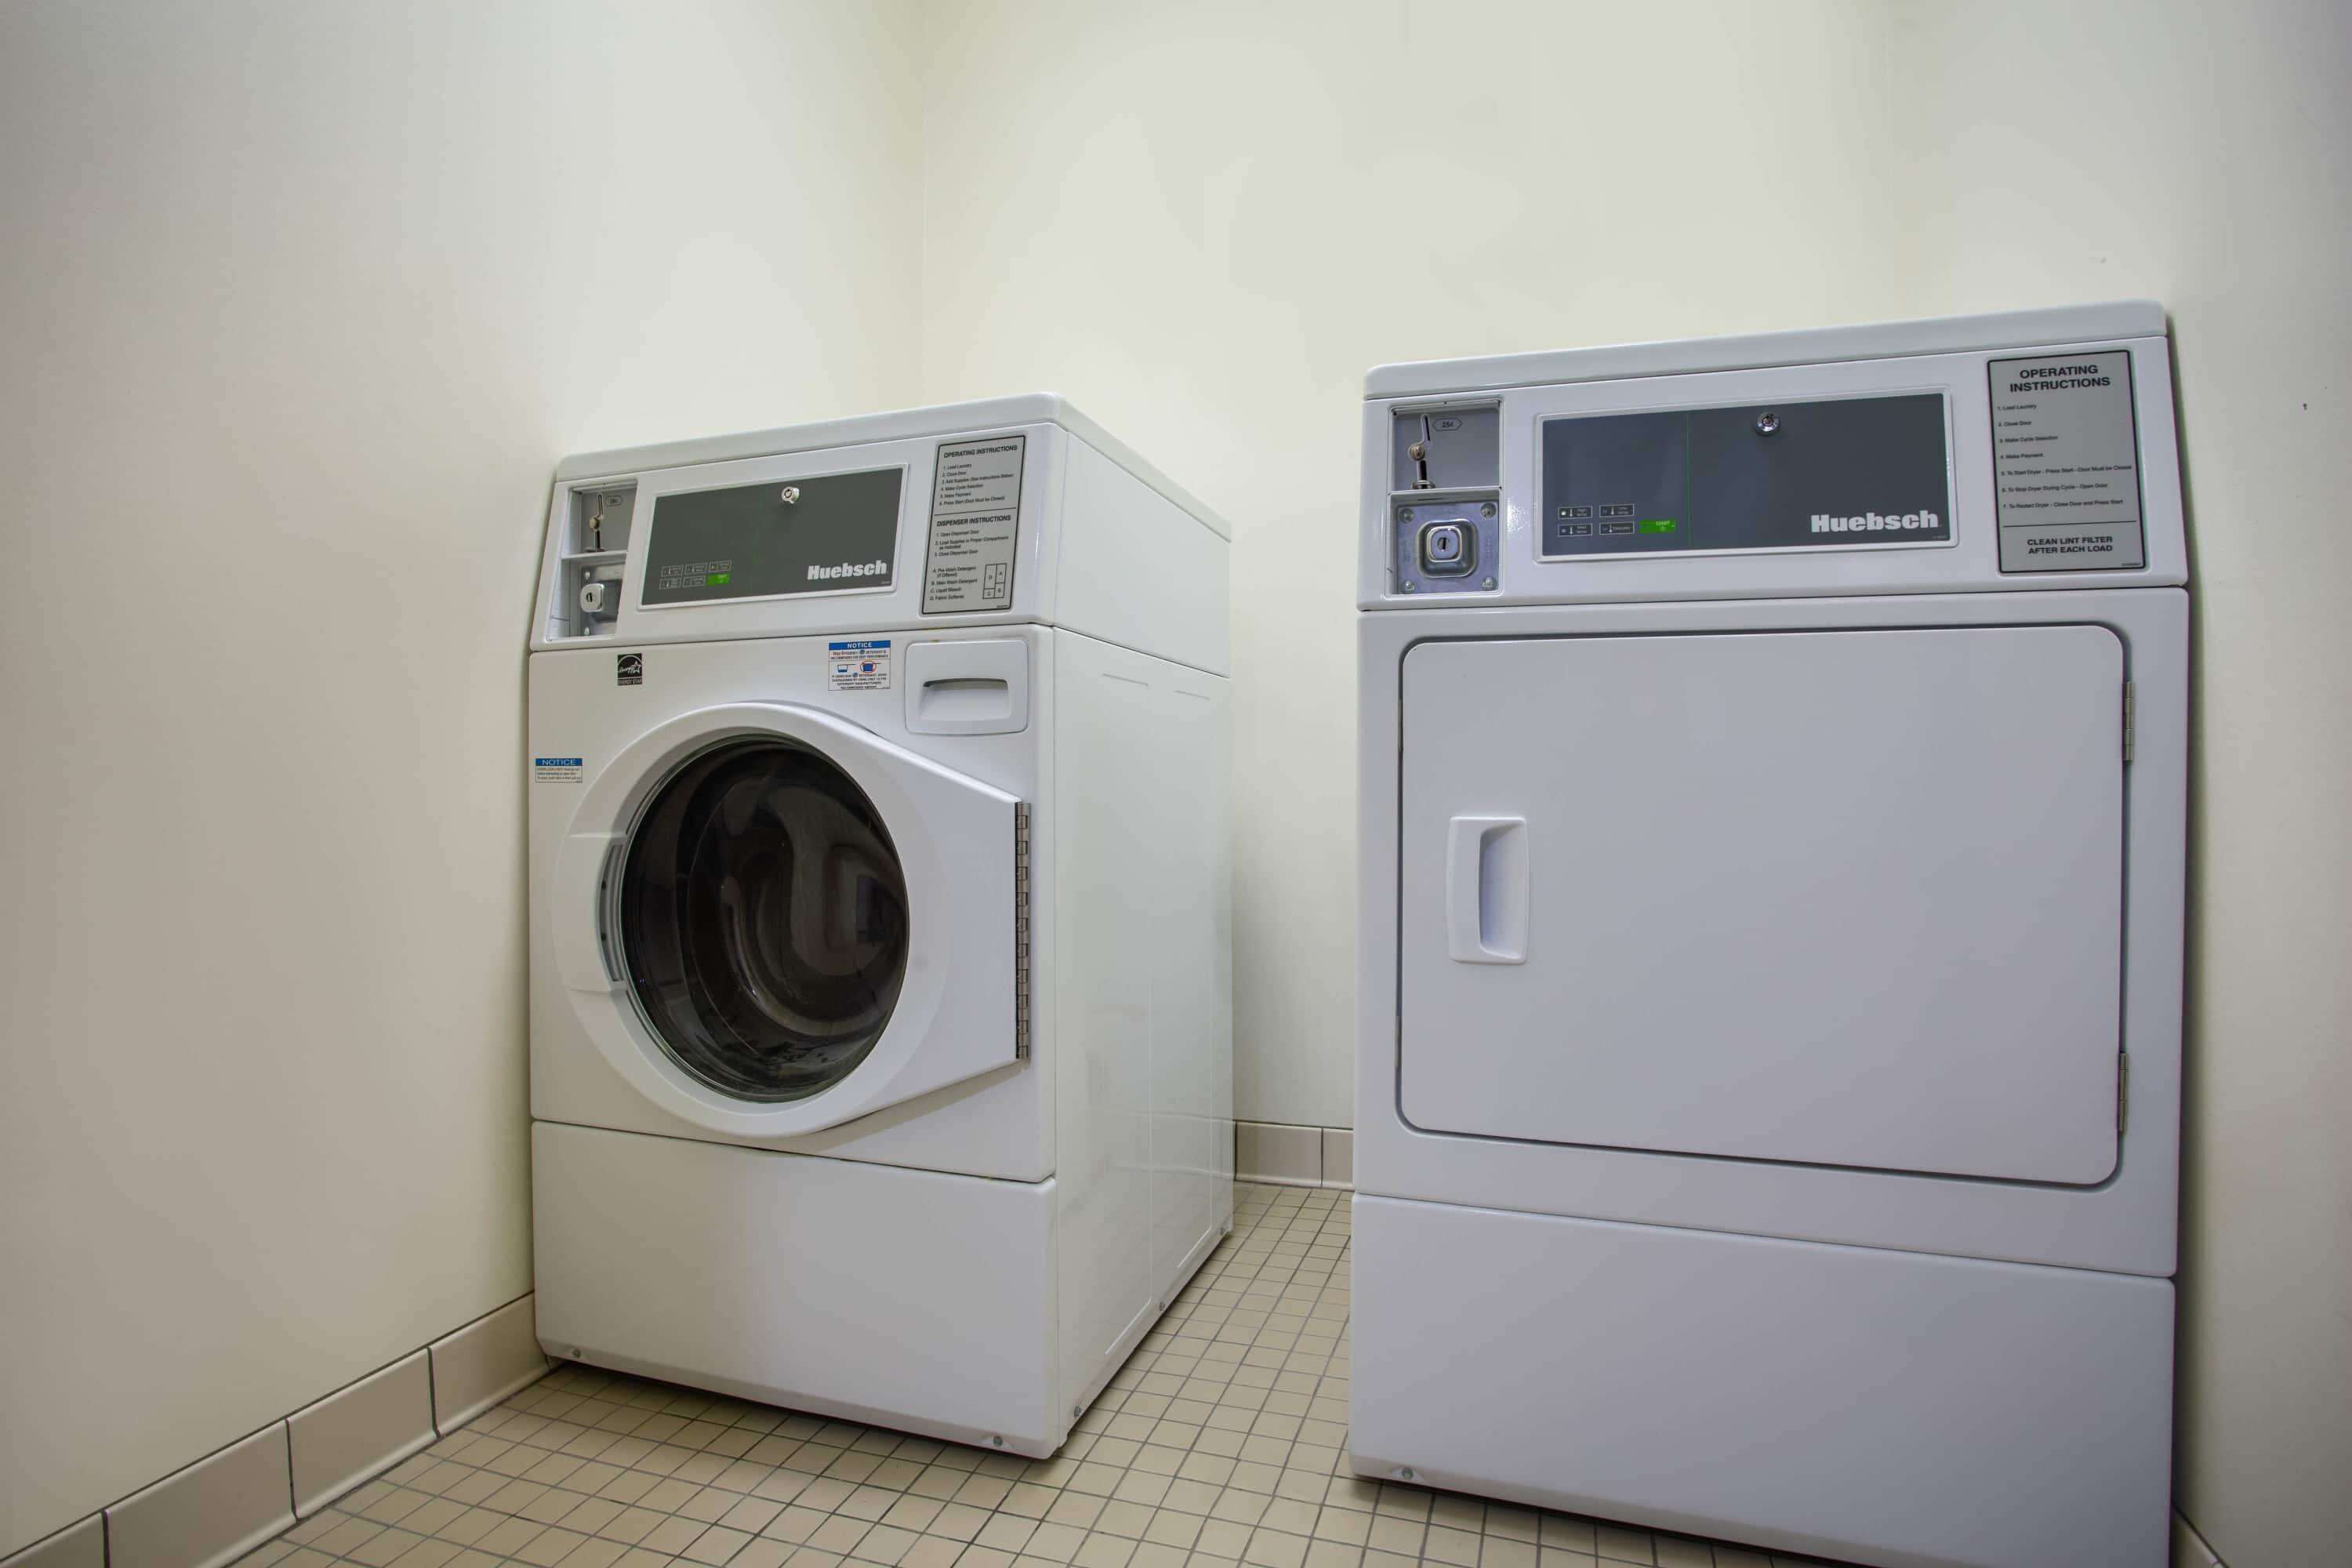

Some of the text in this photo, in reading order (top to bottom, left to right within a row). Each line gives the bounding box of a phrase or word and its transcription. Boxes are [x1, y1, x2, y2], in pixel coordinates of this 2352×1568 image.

[2020, 365, 2098, 379] OPERATING
[2010, 377, 2111, 392] INSTRUCTIONS
[943, 445, 1018, 459] OPERATING INSTRUCTIONS
[937, 514, 1011, 527] DISPENSER INSTRUCTIONS
[1810, 510, 1939, 533] Huebsch
[2027, 538, 2058, 546] CLEAN
[2082, 535, 2113, 544] FILTER
[2027, 546, 2059, 555] AFTER
[807, 560, 887, 581] Huebsch
